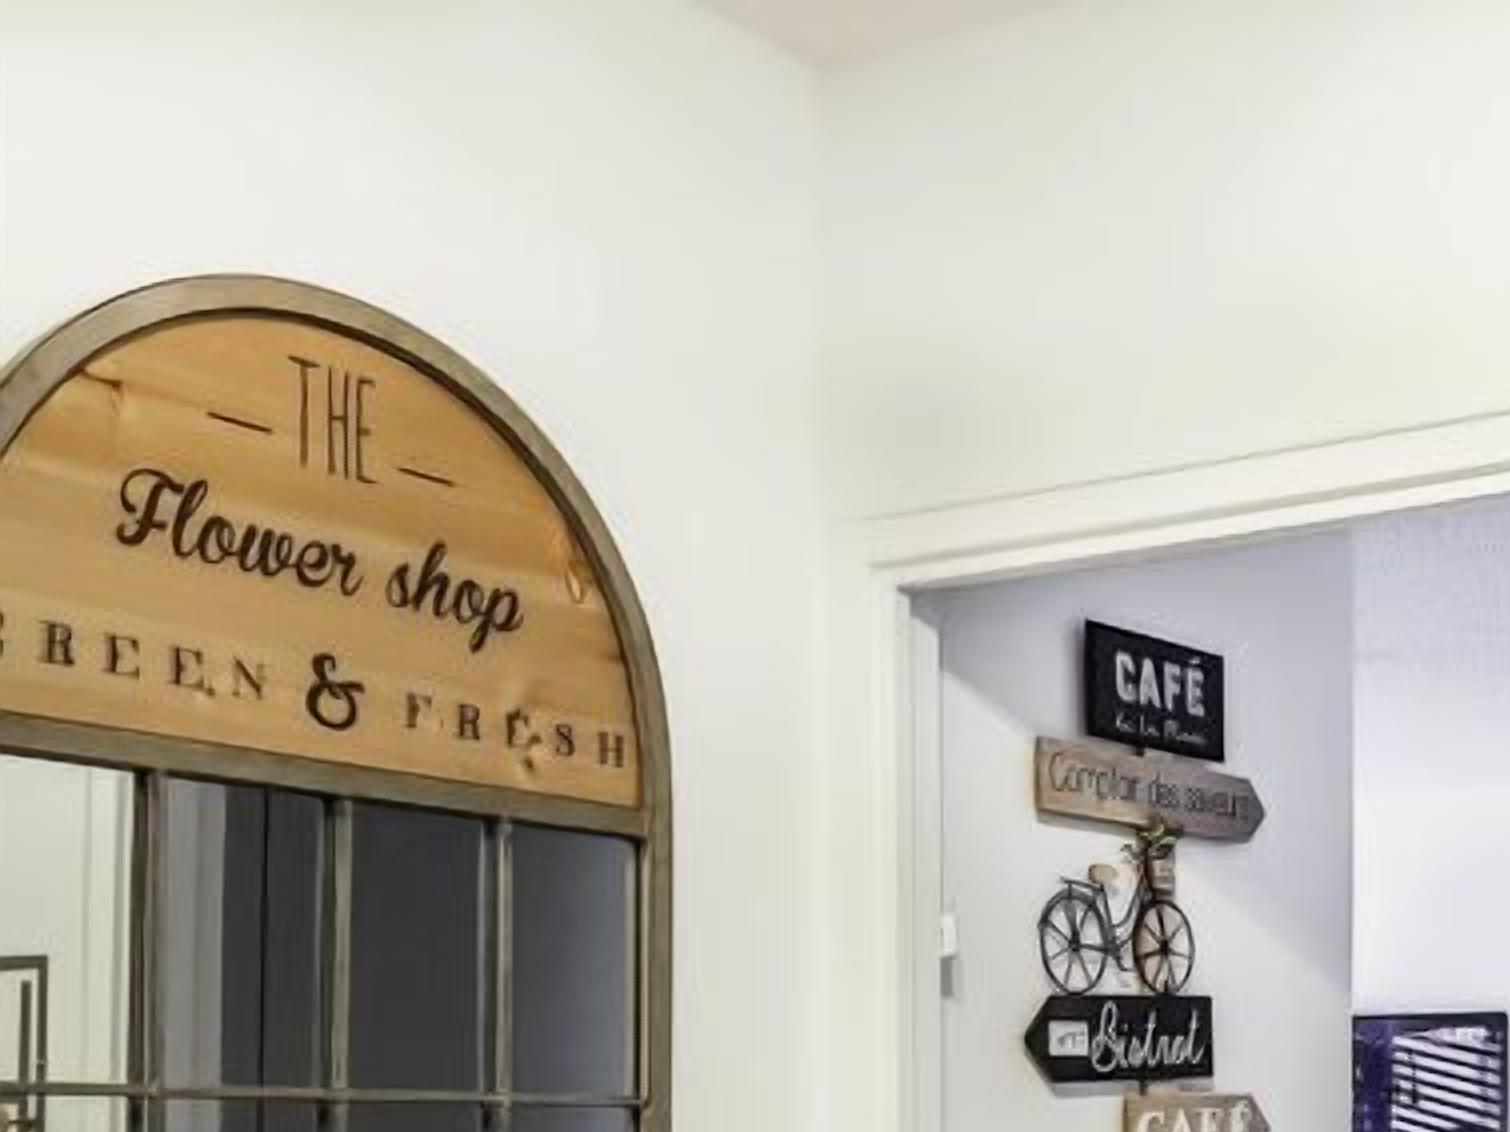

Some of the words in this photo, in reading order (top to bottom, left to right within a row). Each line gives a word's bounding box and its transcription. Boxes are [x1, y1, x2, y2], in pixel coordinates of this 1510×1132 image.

[288, 355, 379, 484] THE
[115, 467, 364, 598] Flower
[384, 540, 524, 653] shop
[0, 612, 268, 701] REEN
[305, 653, 365, 731] &
[404, 691, 625, 768] FRESH
[1114, 650, 1205, 717] CAFÉ
[1091, 1000, 1206, 1073] Bistrot
